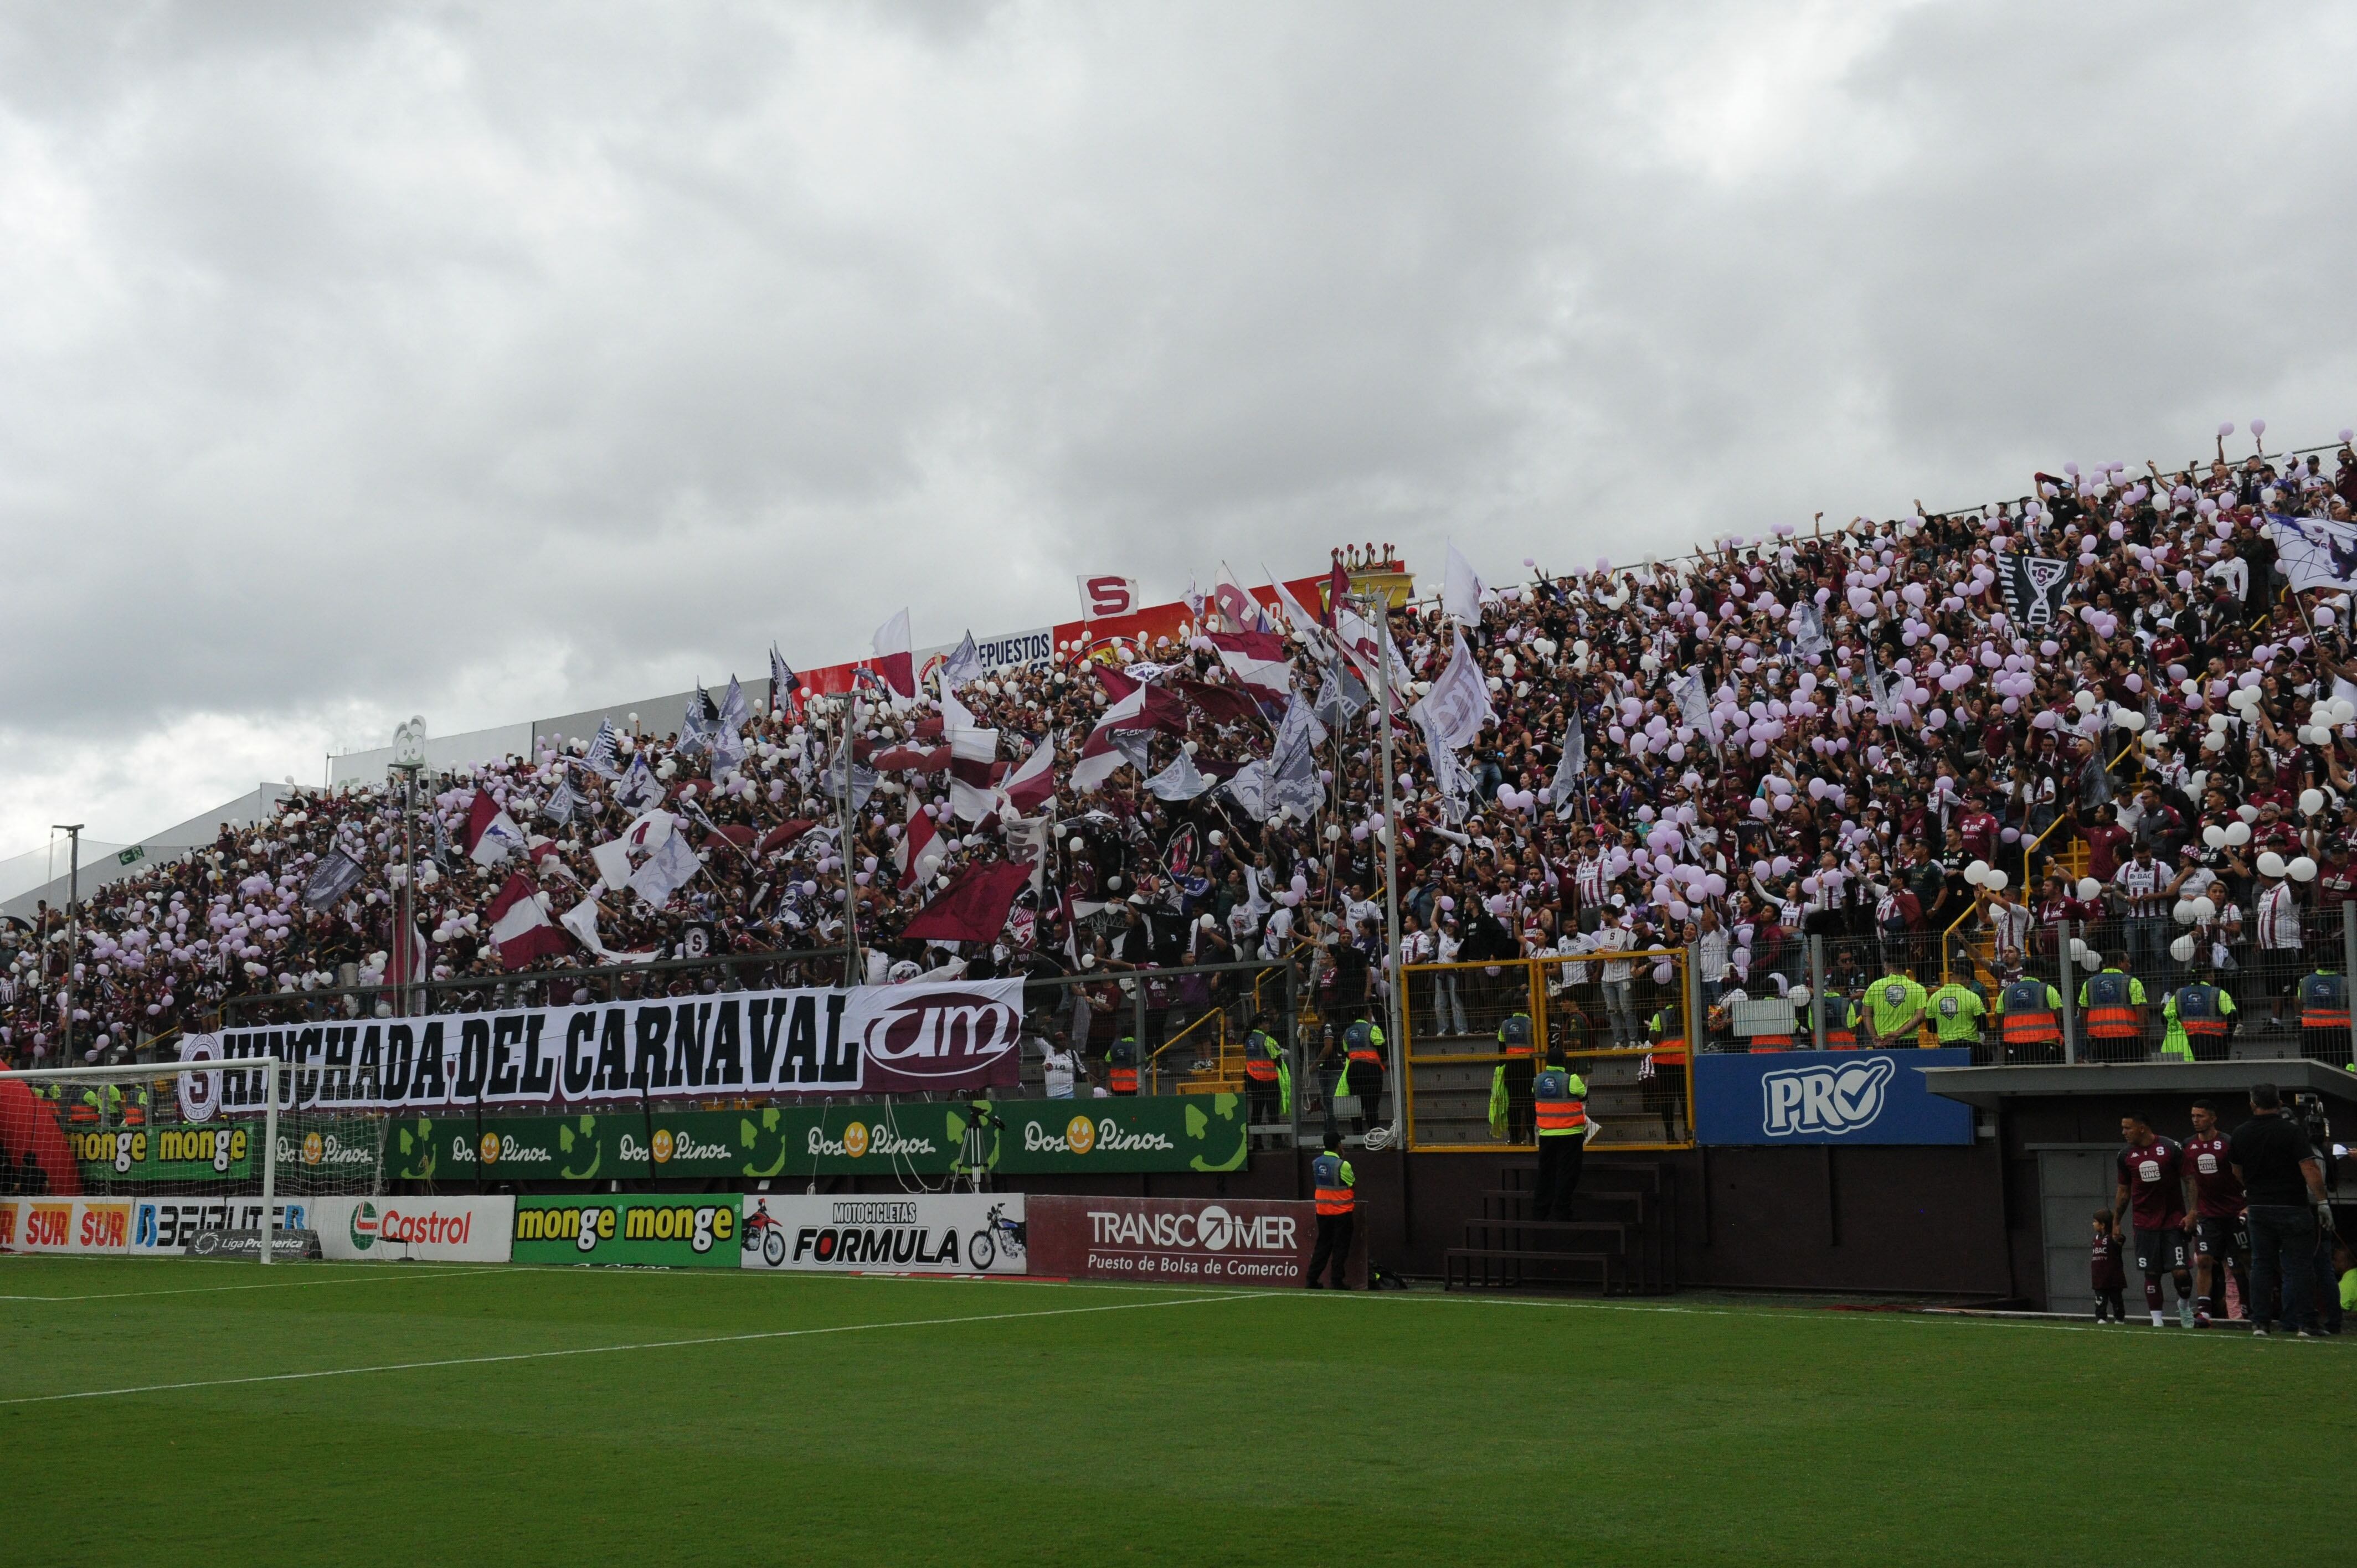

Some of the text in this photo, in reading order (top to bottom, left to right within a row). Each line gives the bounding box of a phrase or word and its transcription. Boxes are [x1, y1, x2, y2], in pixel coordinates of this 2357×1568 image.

[2036, 566, 2048, 584] S
[1087, 577, 1130, 616] S
[692, 935, 702, 952] S
[222, 994, 859, 1105] HINCHADA DEL CARNAVAL
[183, 1099, 215, 1117] COSTA RICA
[808, 1124, 936, 1156] Dos Pinos
[1025, 1117, 1174, 1153] Dos Pinos
[2213, 1141, 2222, 1150] S
[160, 1129, 246, 1171] monge
[323, 1134, 373, 1163] Pinos
[500, 1134, 552, 1162] Pinos
[620, 1131, 732, 1162] Dos Pinos
[2156, 1146, 2164, 1156] S
[2141, 1170, 2160, 1179] KING
[832, 1203, 917, 1224] MOTOCICLETAS
[26, 1211, 69, 1245] SUR
[80, 1211, 125, 1247] SUR
[382, 1210, 471, 1245] Castrol
[516, 1206, 616, 1252] monge
[625, 1205, 735, 1254] monge
[222, 1239, 243, 1250] Liga
[792, 1227, 960, 1265] FORMULA
[2102, 1237, 2108, 1245] S
[2199, 1242, 2207, 1251] S
[2233, 1232, 2248, 1245] 10
[2139, 1257, 2147, 1267] S
[2175, 1246, 2184, 1260] 8
[1088, 1255, 1298, 1276] Puesto de Bolsa de Comercio
[2147, 1286, 2155, 1294] S
